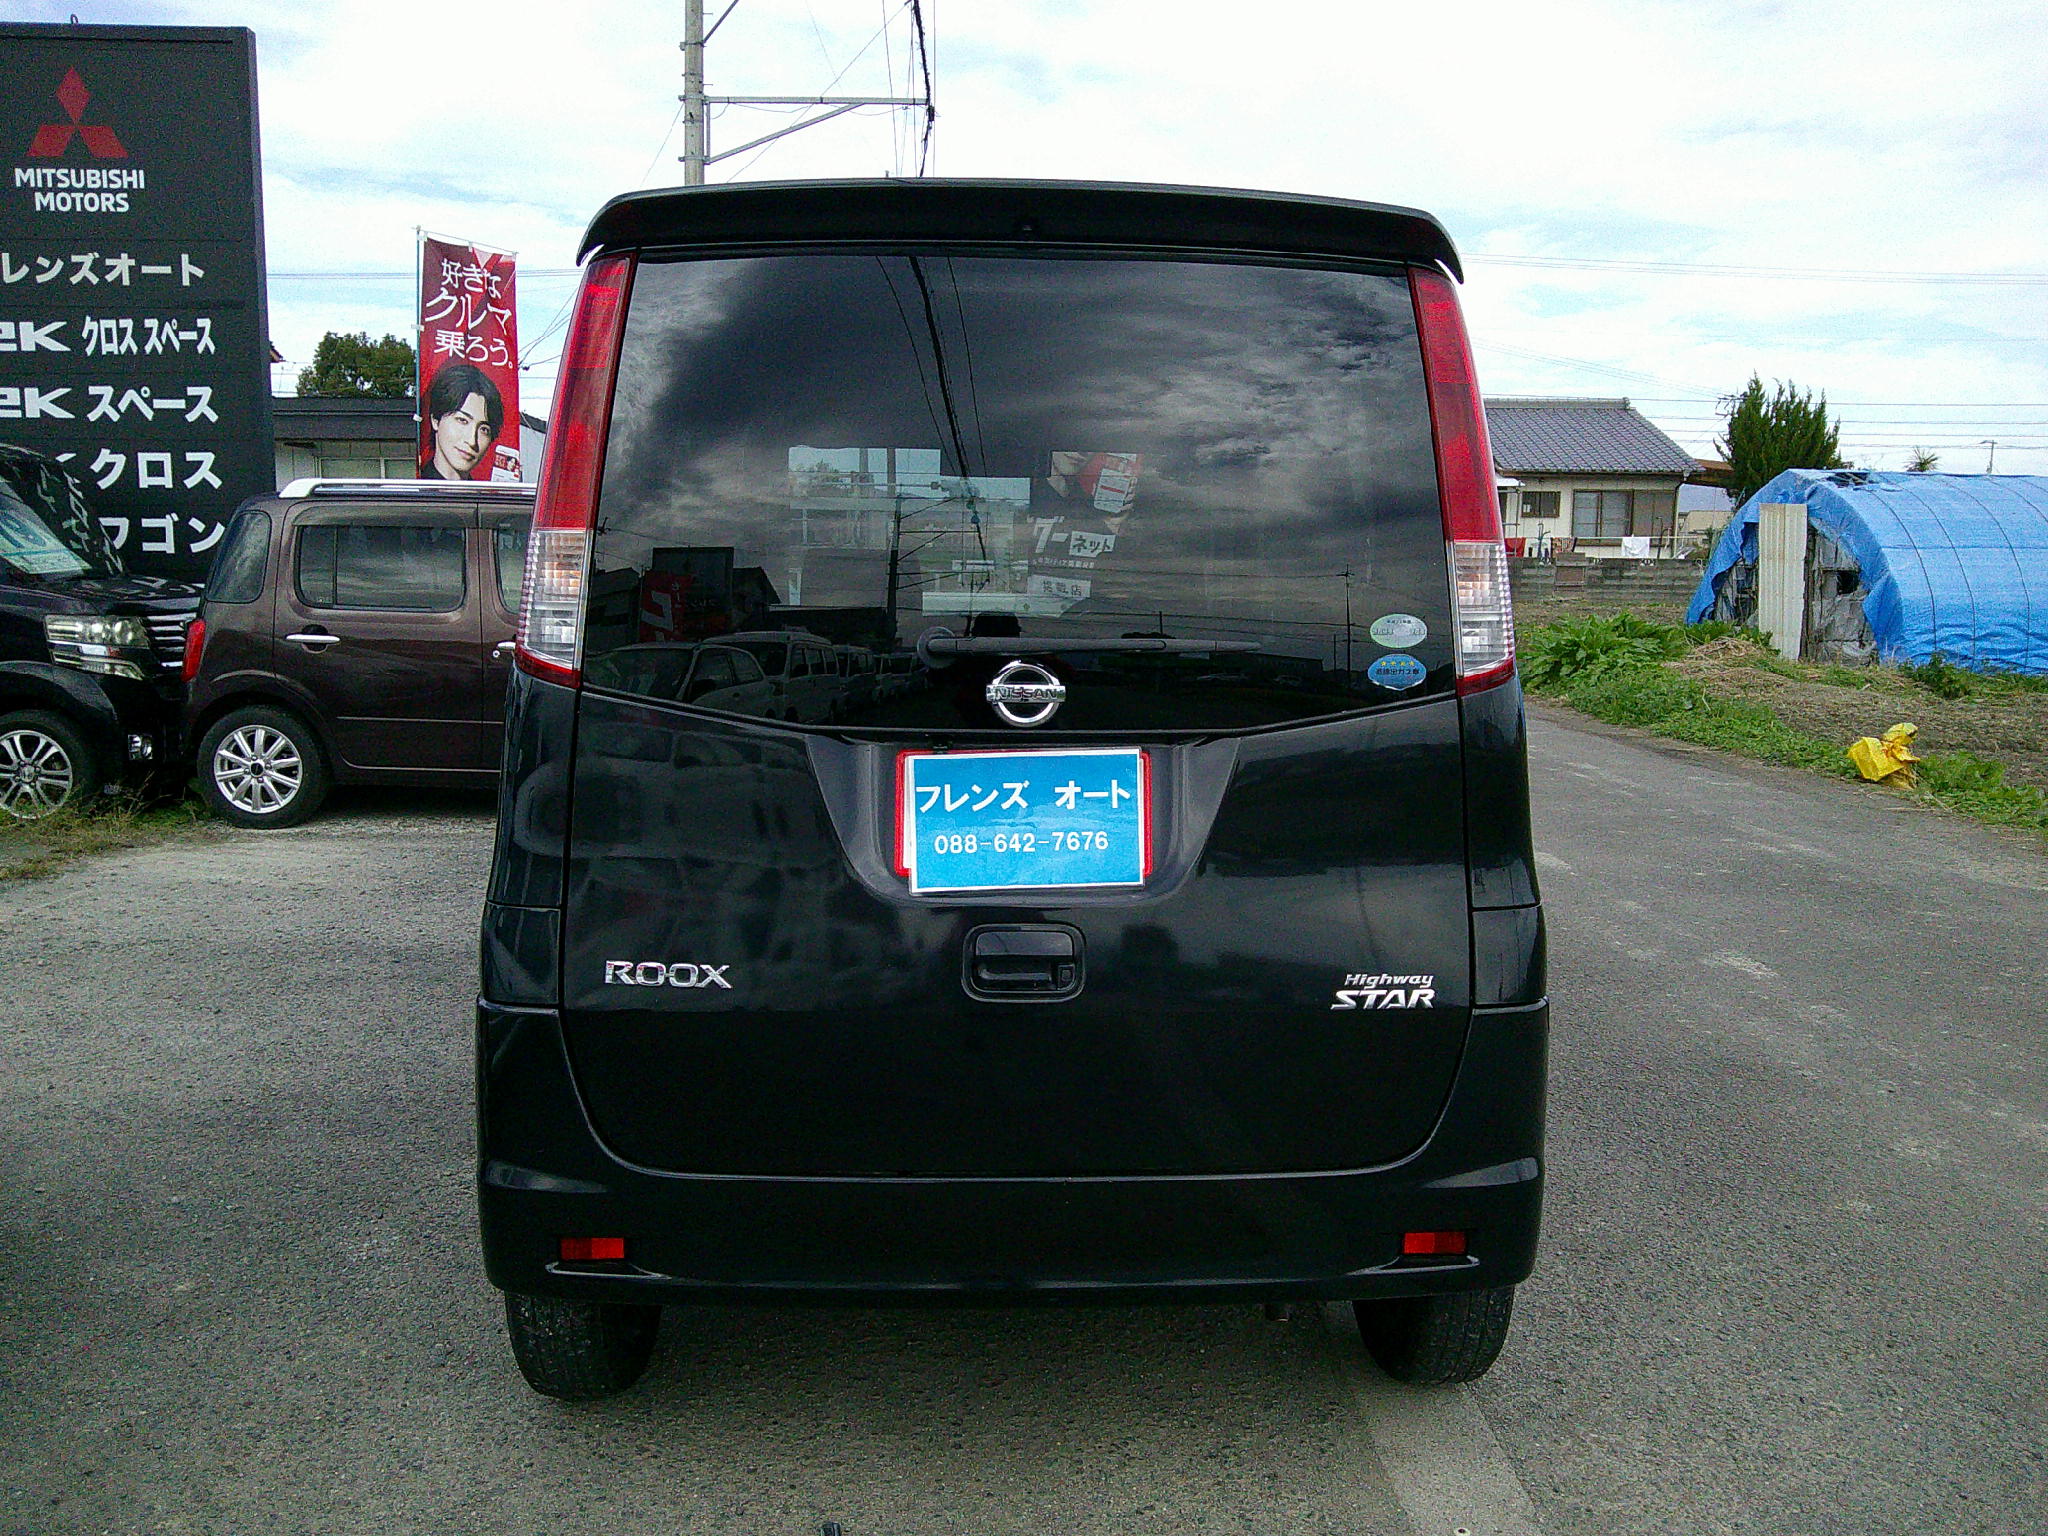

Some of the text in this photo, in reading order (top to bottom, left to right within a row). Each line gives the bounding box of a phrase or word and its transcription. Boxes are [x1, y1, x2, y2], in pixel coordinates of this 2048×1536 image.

[14, 167, 145, 189] MITSUBISHI
[34, 192, 130, 213] MOTORS
[1, 252, 205, 287] レンズオート
[441, 257, 502, 300] 好きな
[424, 286, 512, 336] クルマ
[81, 315, 138, 356] クロス
[144, 317, 216, 355] スペース
[433, 329, 513, 369] 乗ろう。
[86, 385, 219, 423] スペース
[90, 447, 223, 490] クロス
[994, 686, 1057, 700] NISSAN
[915, 779, 1131, 813] フレンズ オート
[934, 831, 1109, 854] 088-642-7676
[604, 960, 732, 989] ROOX
[1344, 973, 1434, 990] Highway
[1330, 988, 1436, 1010] STAR
